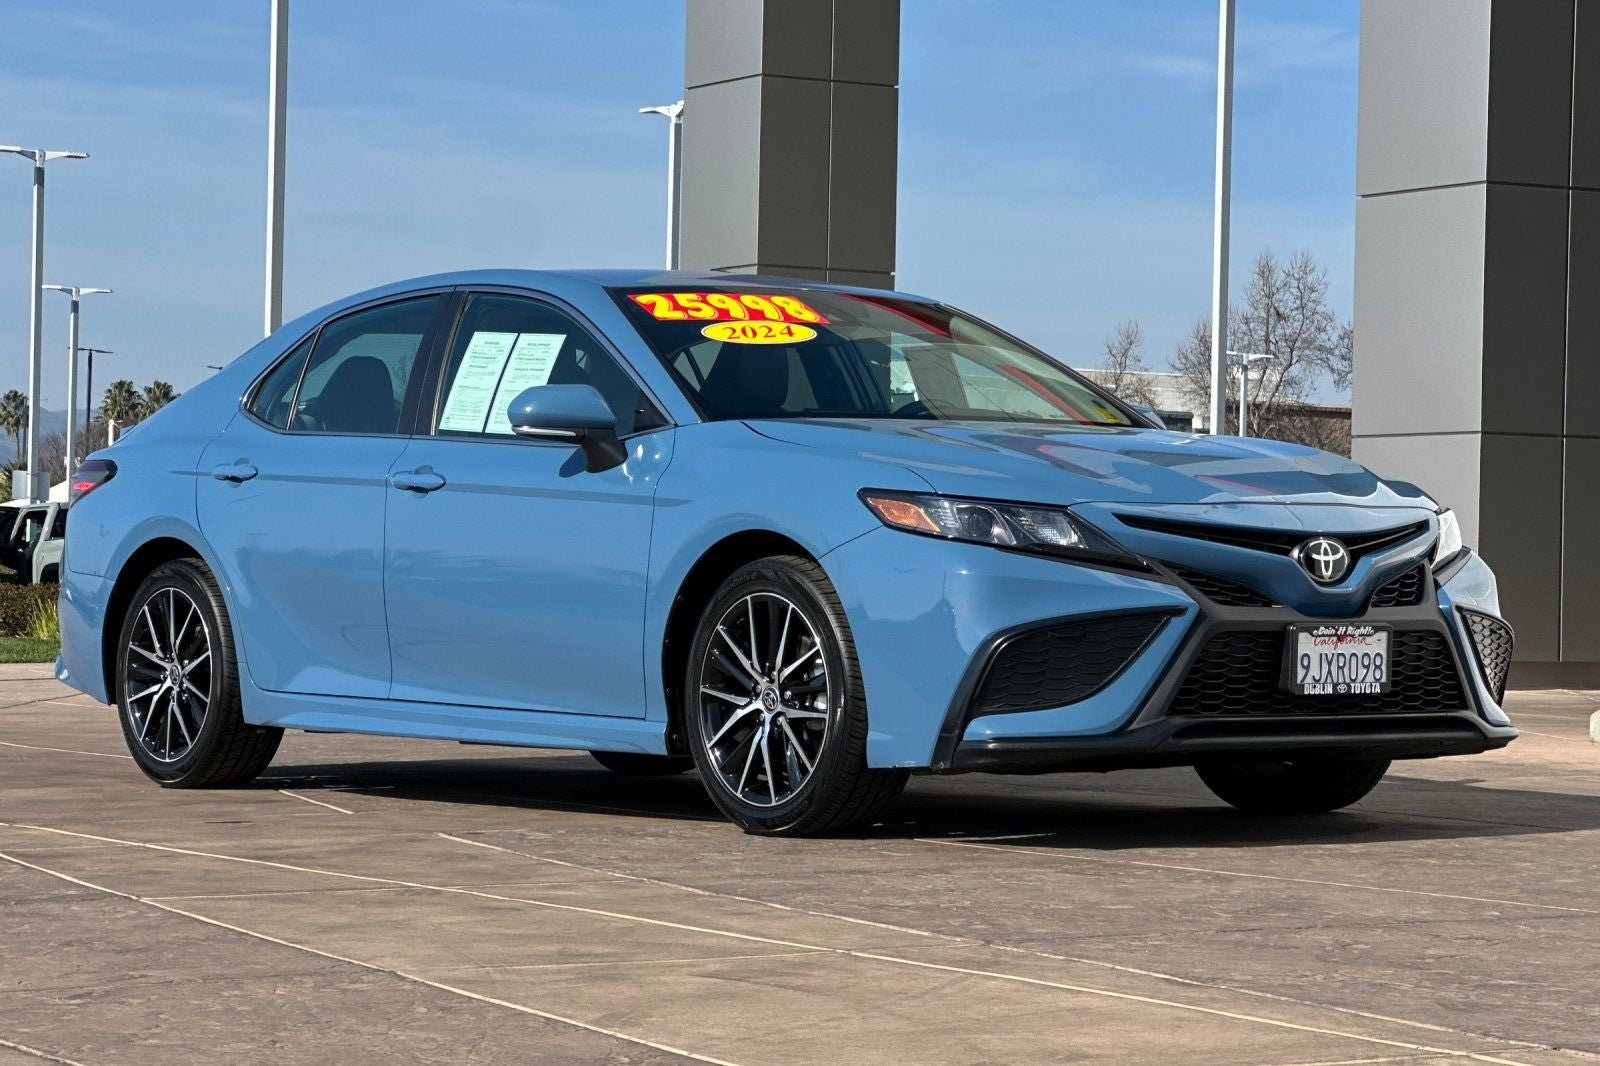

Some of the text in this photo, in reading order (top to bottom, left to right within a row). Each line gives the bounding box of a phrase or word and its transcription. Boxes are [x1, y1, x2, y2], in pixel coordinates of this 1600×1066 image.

[635, 293, 820, 322] 25998
[722, 324, 796, 340] 2024
[1300, 652, 1383, 683] 9JXR098
[1304, 683, 1381, 694] DUBLIN TOYOTA
